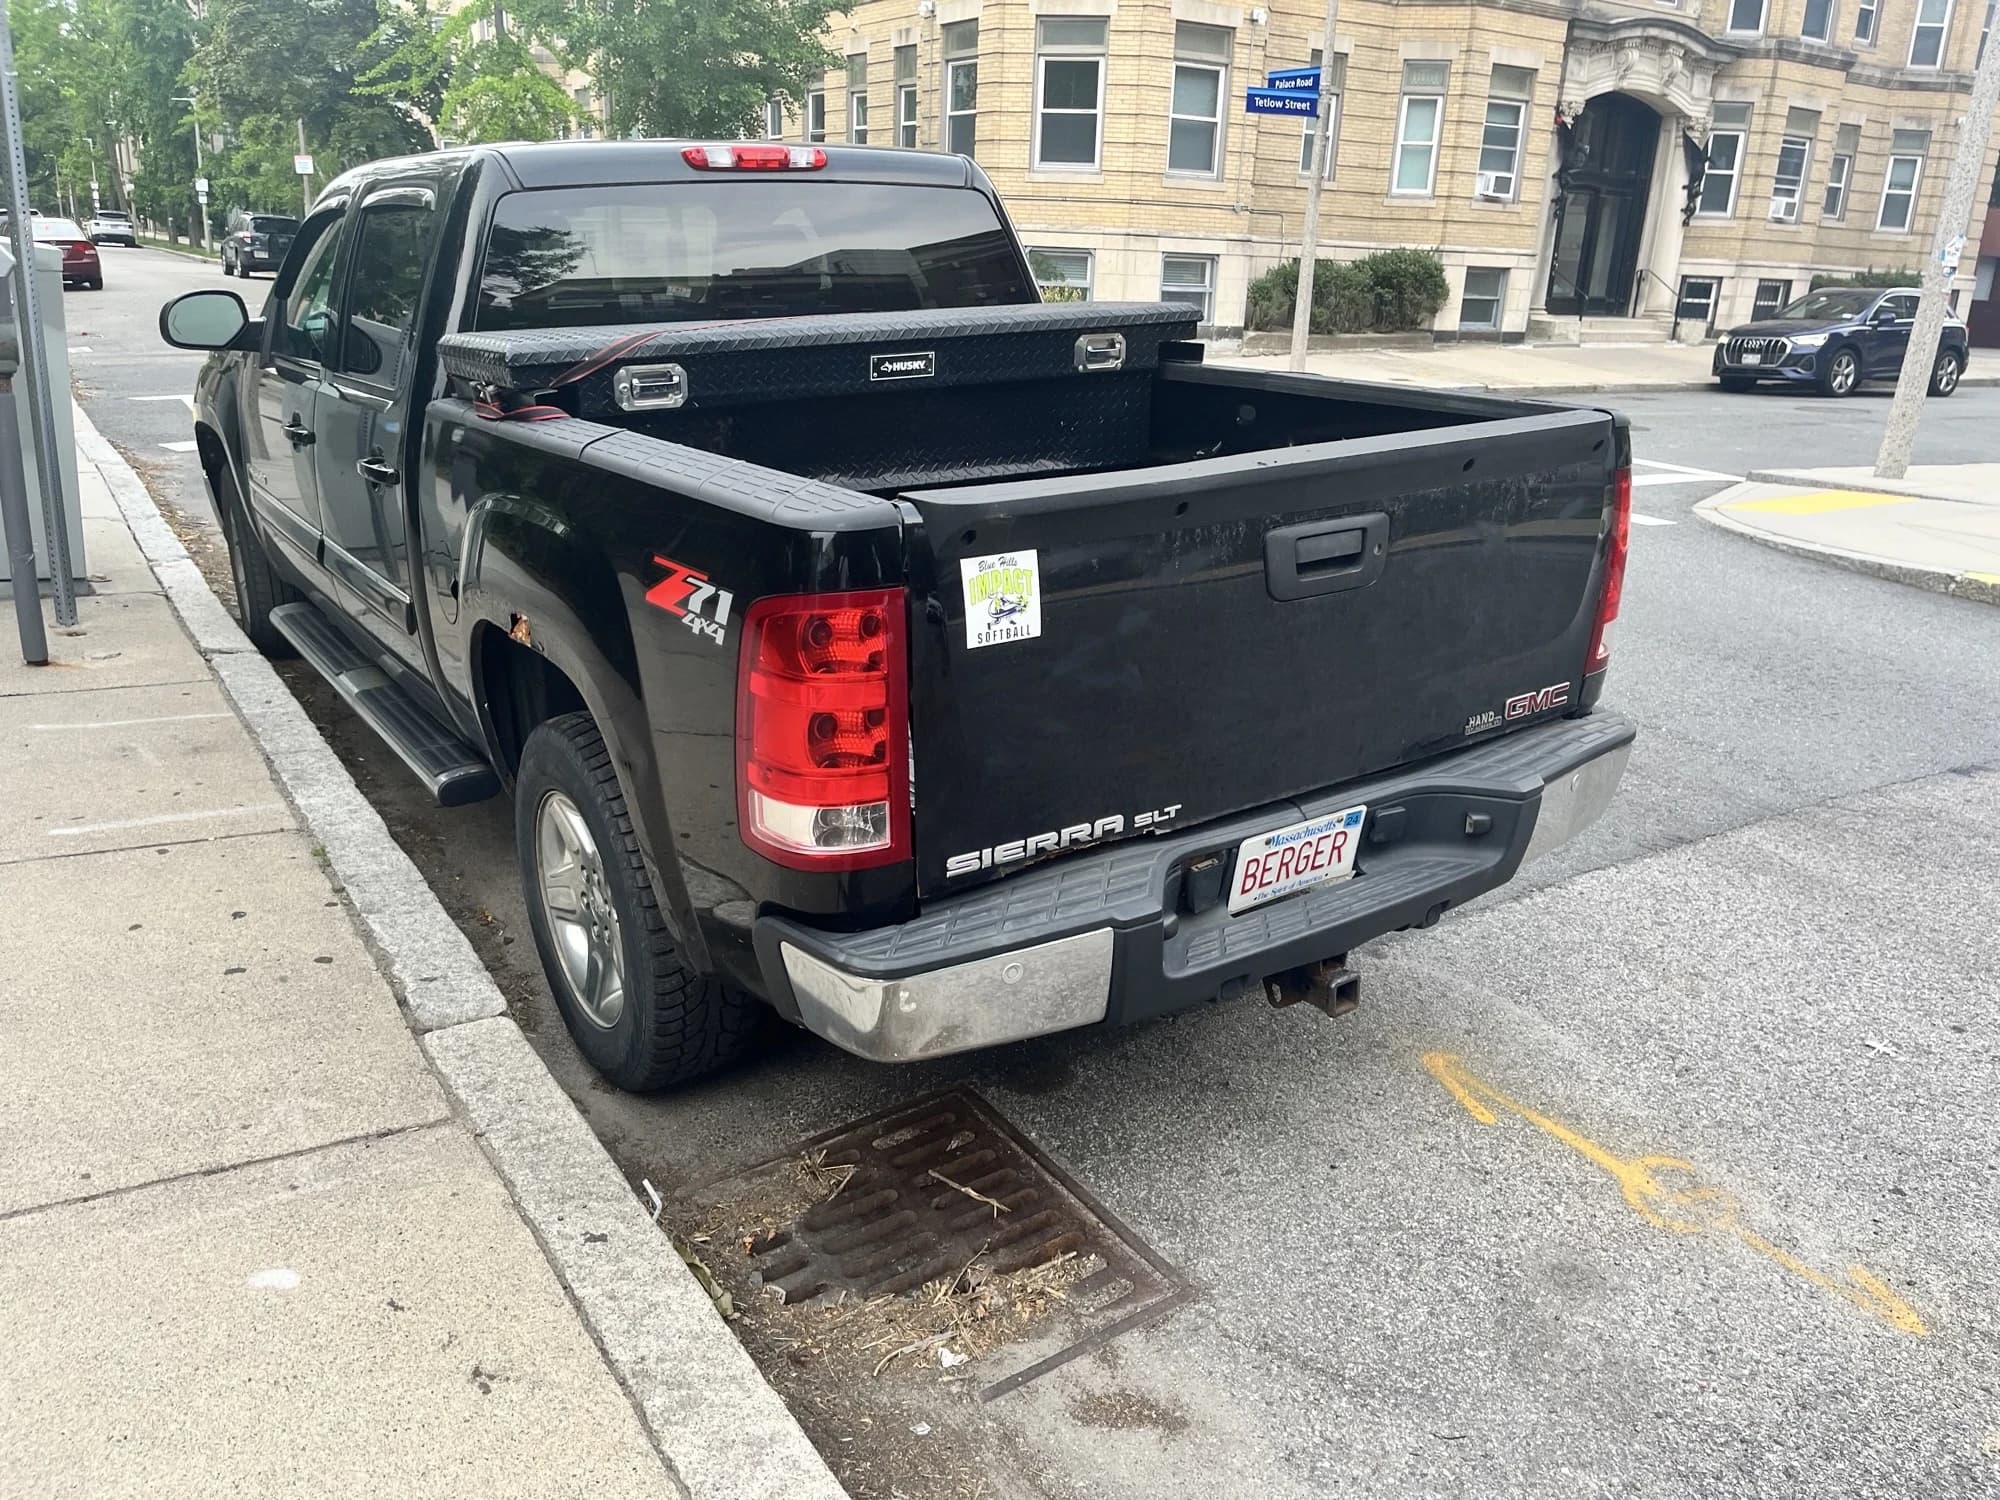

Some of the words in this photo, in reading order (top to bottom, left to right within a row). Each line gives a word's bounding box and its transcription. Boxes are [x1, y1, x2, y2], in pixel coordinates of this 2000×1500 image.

[1275, 78, 1296, 89] Palace
[1296, 76, 1313, 87] Road
[1254, 97, 1284, 108] Tetlow
[1285, 99, 1311, 111] Street
[892, 360, 926, 371] HUSKY
[978, 560, 996, 572] Blue
[998, 556, 1018, 567] Hills
[645, 556, 733, 625] Z71
[968, 568, 1033, 606] IMPACT
[978, 624, 1031, 644] SOFTBALL
[1505, 682, 1570, 720] GMC
[1468, 711, 1495, 728] HAND
[1346, 815, 1359, 826] 24
[946, 814, 1124, 878] SIERRA
[1134, 804, 1182, 828] SLT
[1269, 820, 1337, 848] Massachusetts
[1240, 830, 1348, 895] BERGER
